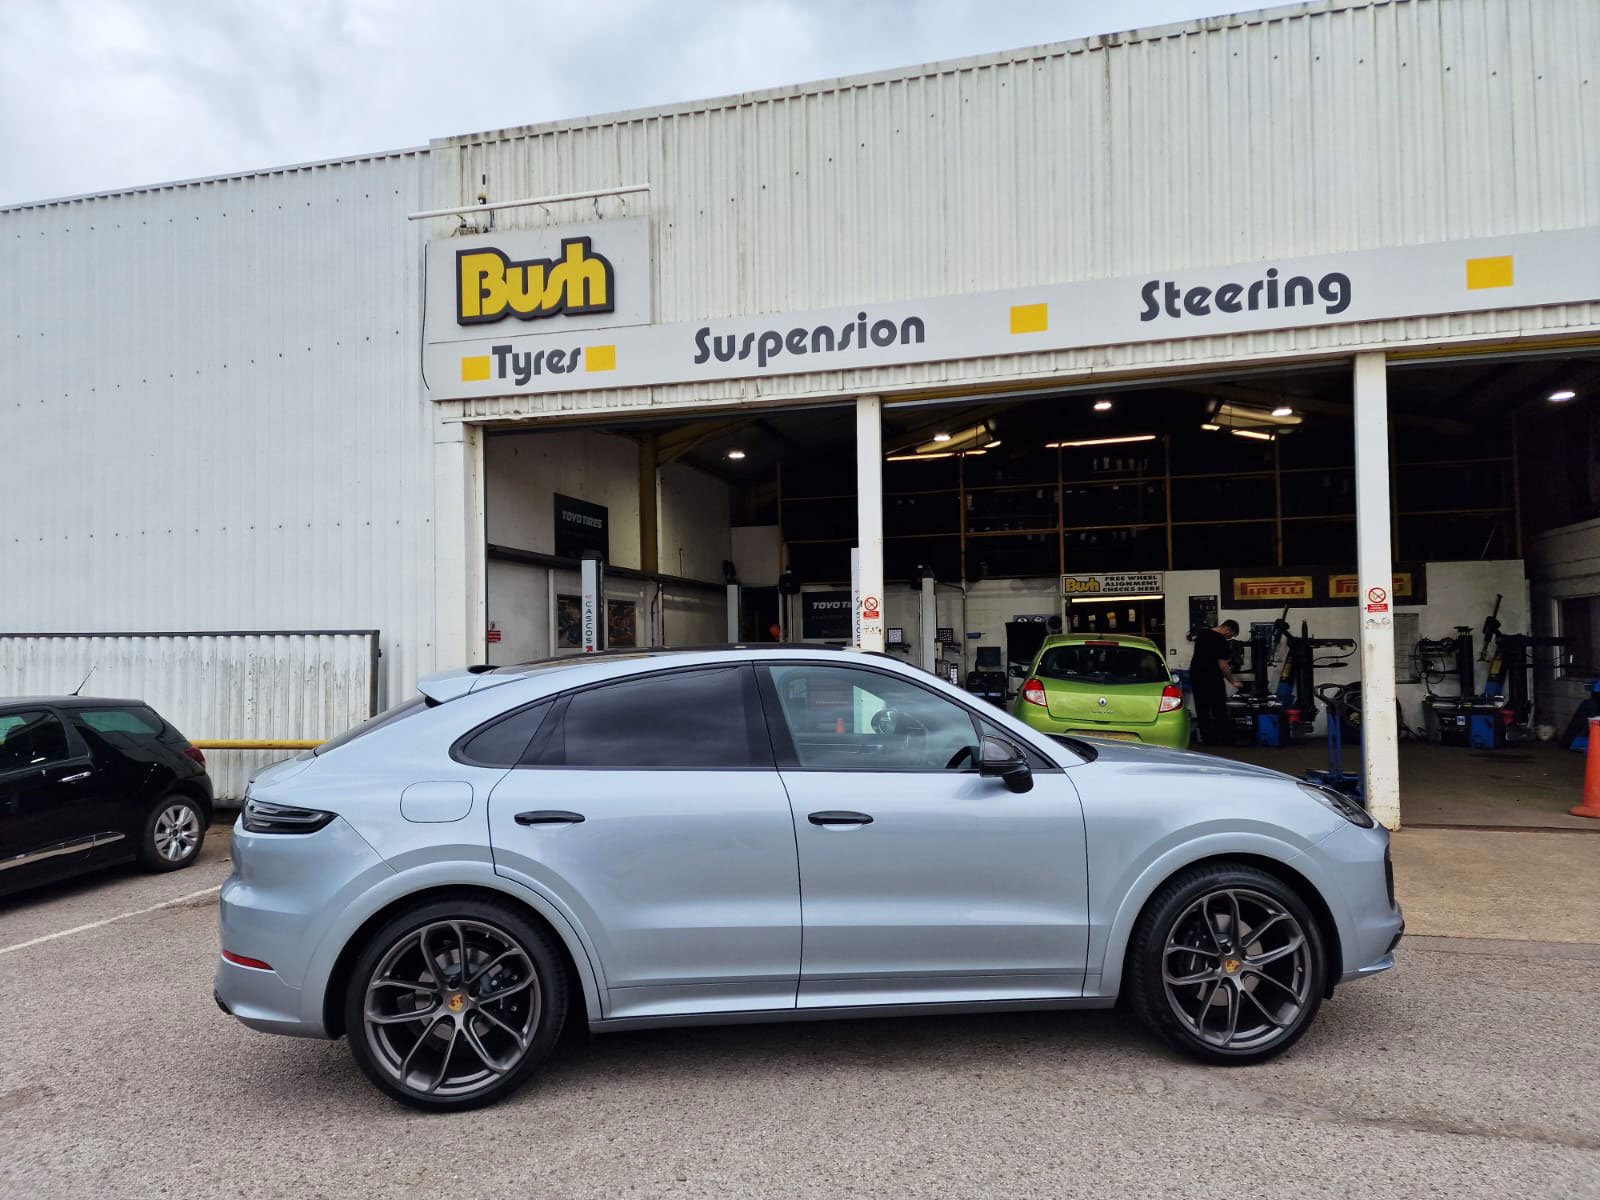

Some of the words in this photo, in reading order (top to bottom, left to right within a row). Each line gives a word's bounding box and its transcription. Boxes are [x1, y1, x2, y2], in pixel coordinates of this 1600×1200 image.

[456, 236, 614, 325] Bush
[1140, 267, 1352, 322] Steering
[694, 311, 925, 368] Suspension
[492, 344, 581, 386] Tyres
[562, 510, 582, 523] TOYO
[582, 515, 602, 528] TIRES
[812, 601, 840, 609] TOYO
[1065, 577, 1100, 593] Bush
[1240, 580, 1305, 596] PIRELLI
[585, 600, 593, 644] CASCOS
